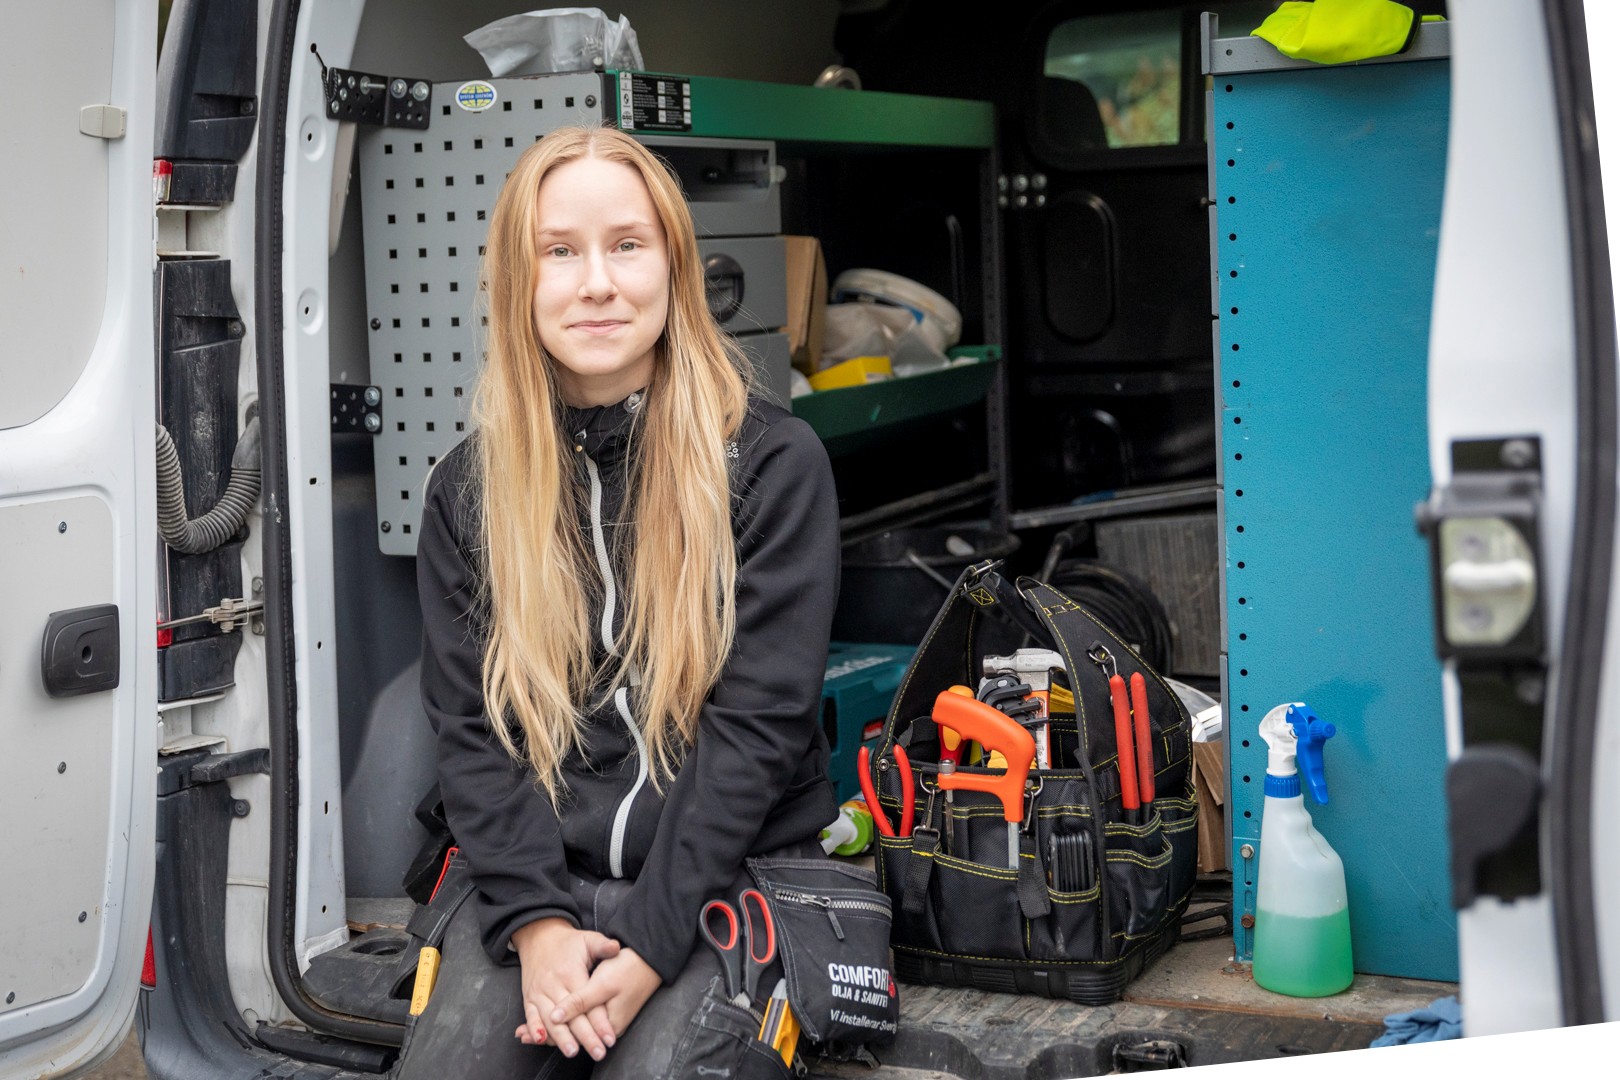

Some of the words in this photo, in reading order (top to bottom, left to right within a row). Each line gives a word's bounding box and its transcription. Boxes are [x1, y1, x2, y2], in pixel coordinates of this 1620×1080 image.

[832, 983, 853, 1001] OLJA
[854, 988, 861, 1002] &
[830, 1008, 840, 1021] Vi
[839, 1011, 881, 1030] installerar
